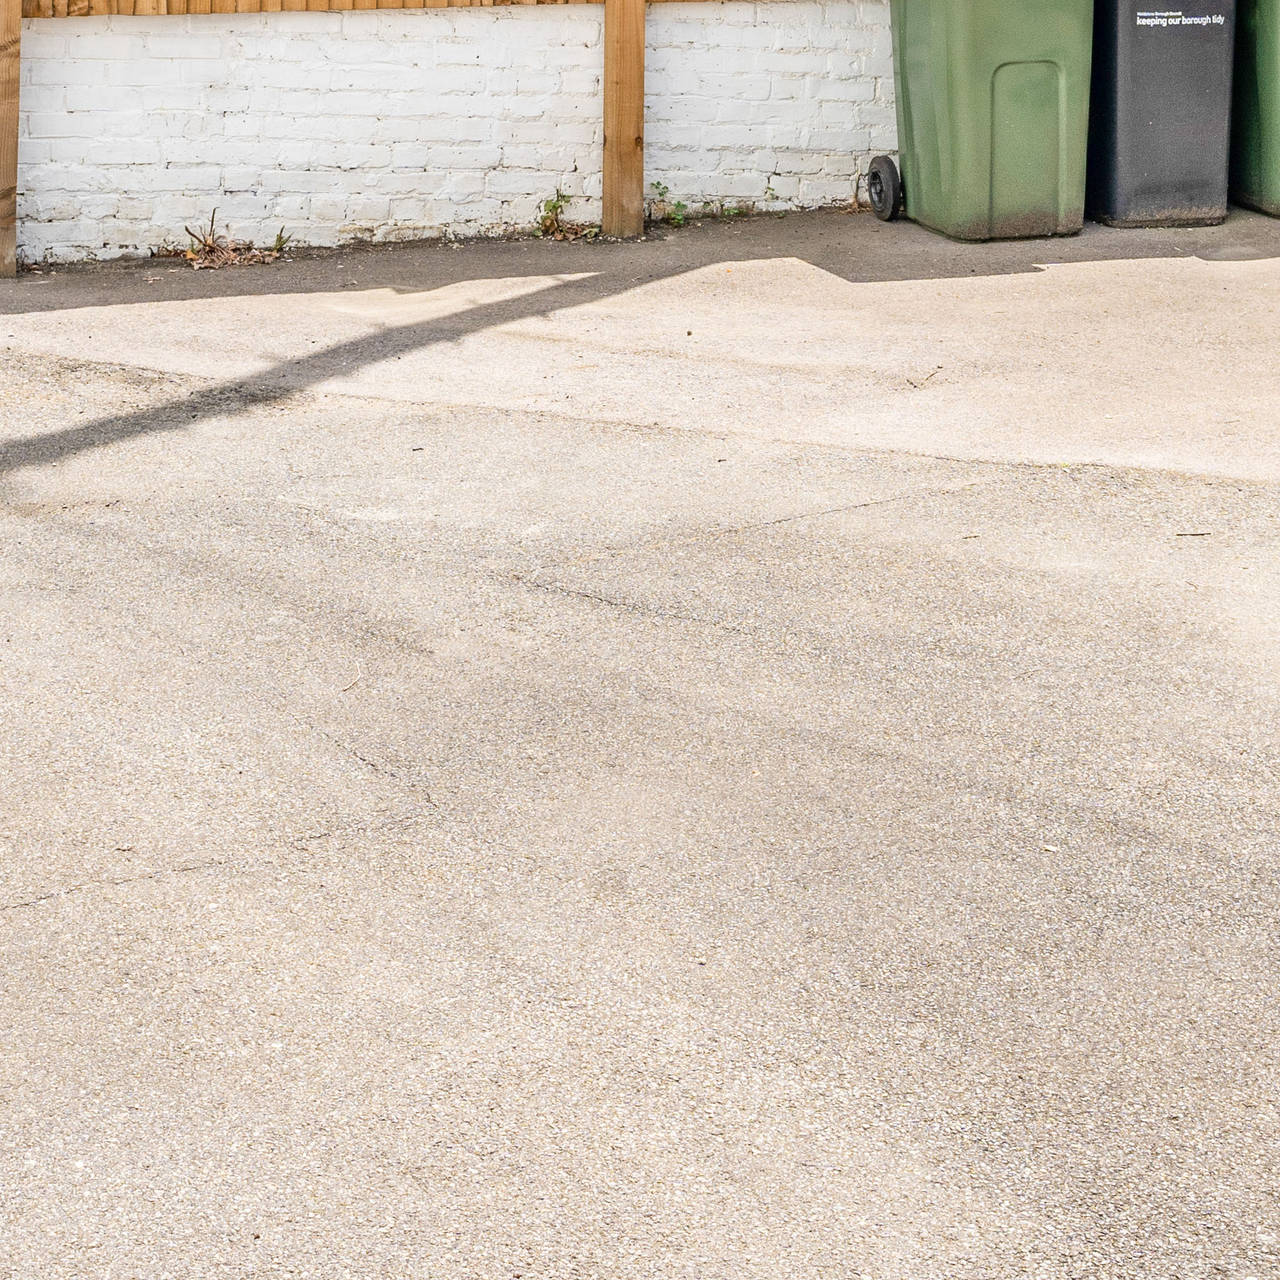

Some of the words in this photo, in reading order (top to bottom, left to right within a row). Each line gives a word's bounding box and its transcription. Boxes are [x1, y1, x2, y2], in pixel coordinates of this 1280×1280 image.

[1136, 16, 1167, 27] keeping
[1167, 17, 1181, 25] our
[1181, 15, 1211, 26] borough
[1211, 14, 1225, 25] tidy
